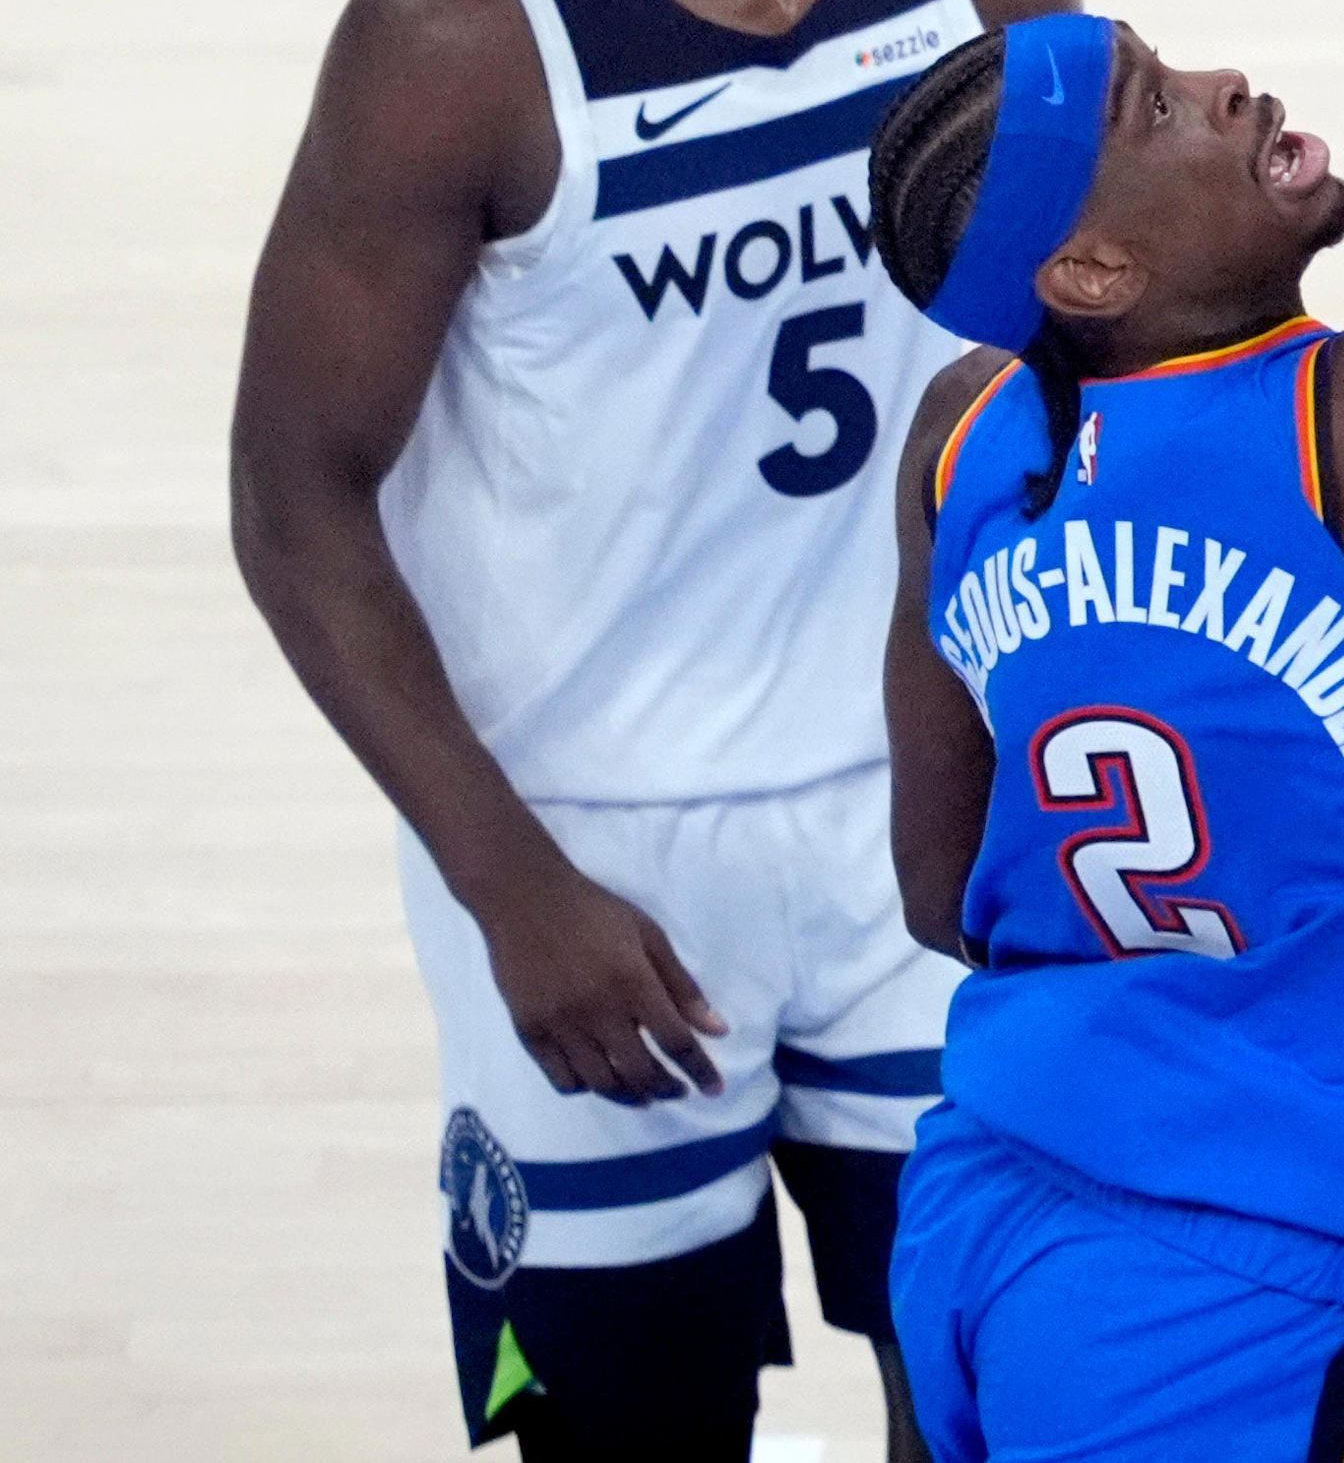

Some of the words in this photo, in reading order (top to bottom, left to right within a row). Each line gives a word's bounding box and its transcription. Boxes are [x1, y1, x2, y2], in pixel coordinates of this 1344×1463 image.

[871, 26, 940, 66] sezzle
[757, 300, 878, 498] 5
[1029, 703, 1249, 962] 2
